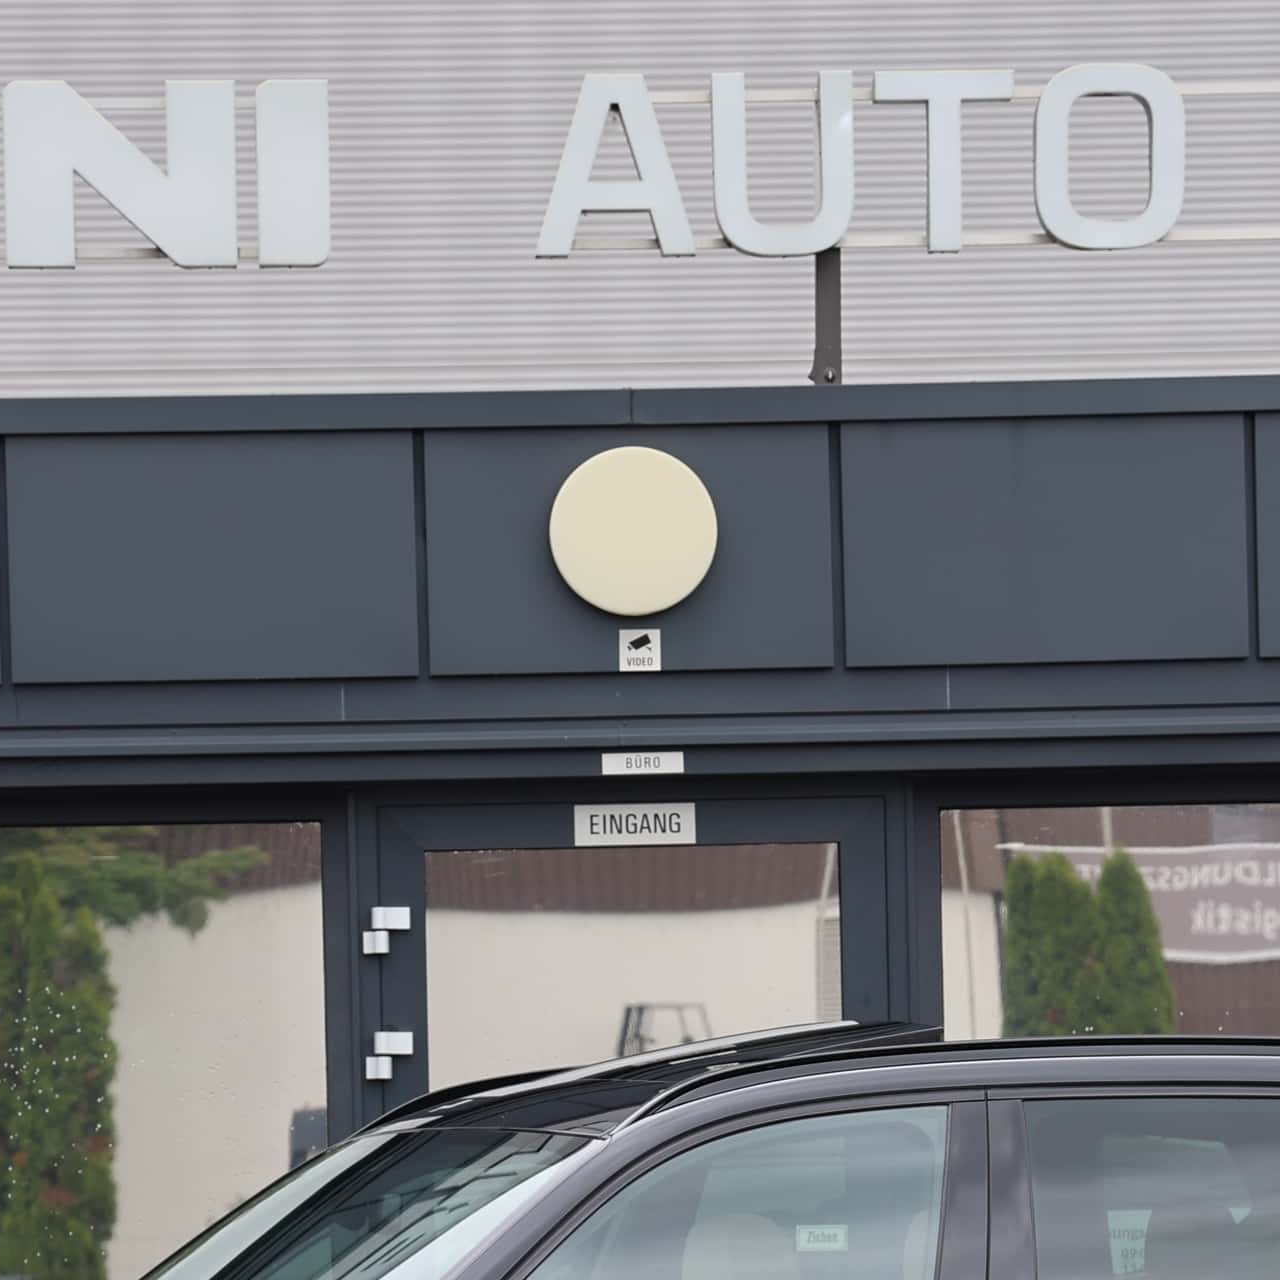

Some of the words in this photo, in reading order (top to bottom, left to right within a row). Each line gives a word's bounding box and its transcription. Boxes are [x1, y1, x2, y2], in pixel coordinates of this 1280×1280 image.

[535, 61, 1187, 258] AUTO
[626, 656, 654, 667] VIDEO
[625, 754, 662, 769] BÜRO
[589, 812, 683, 835] EINGANG
